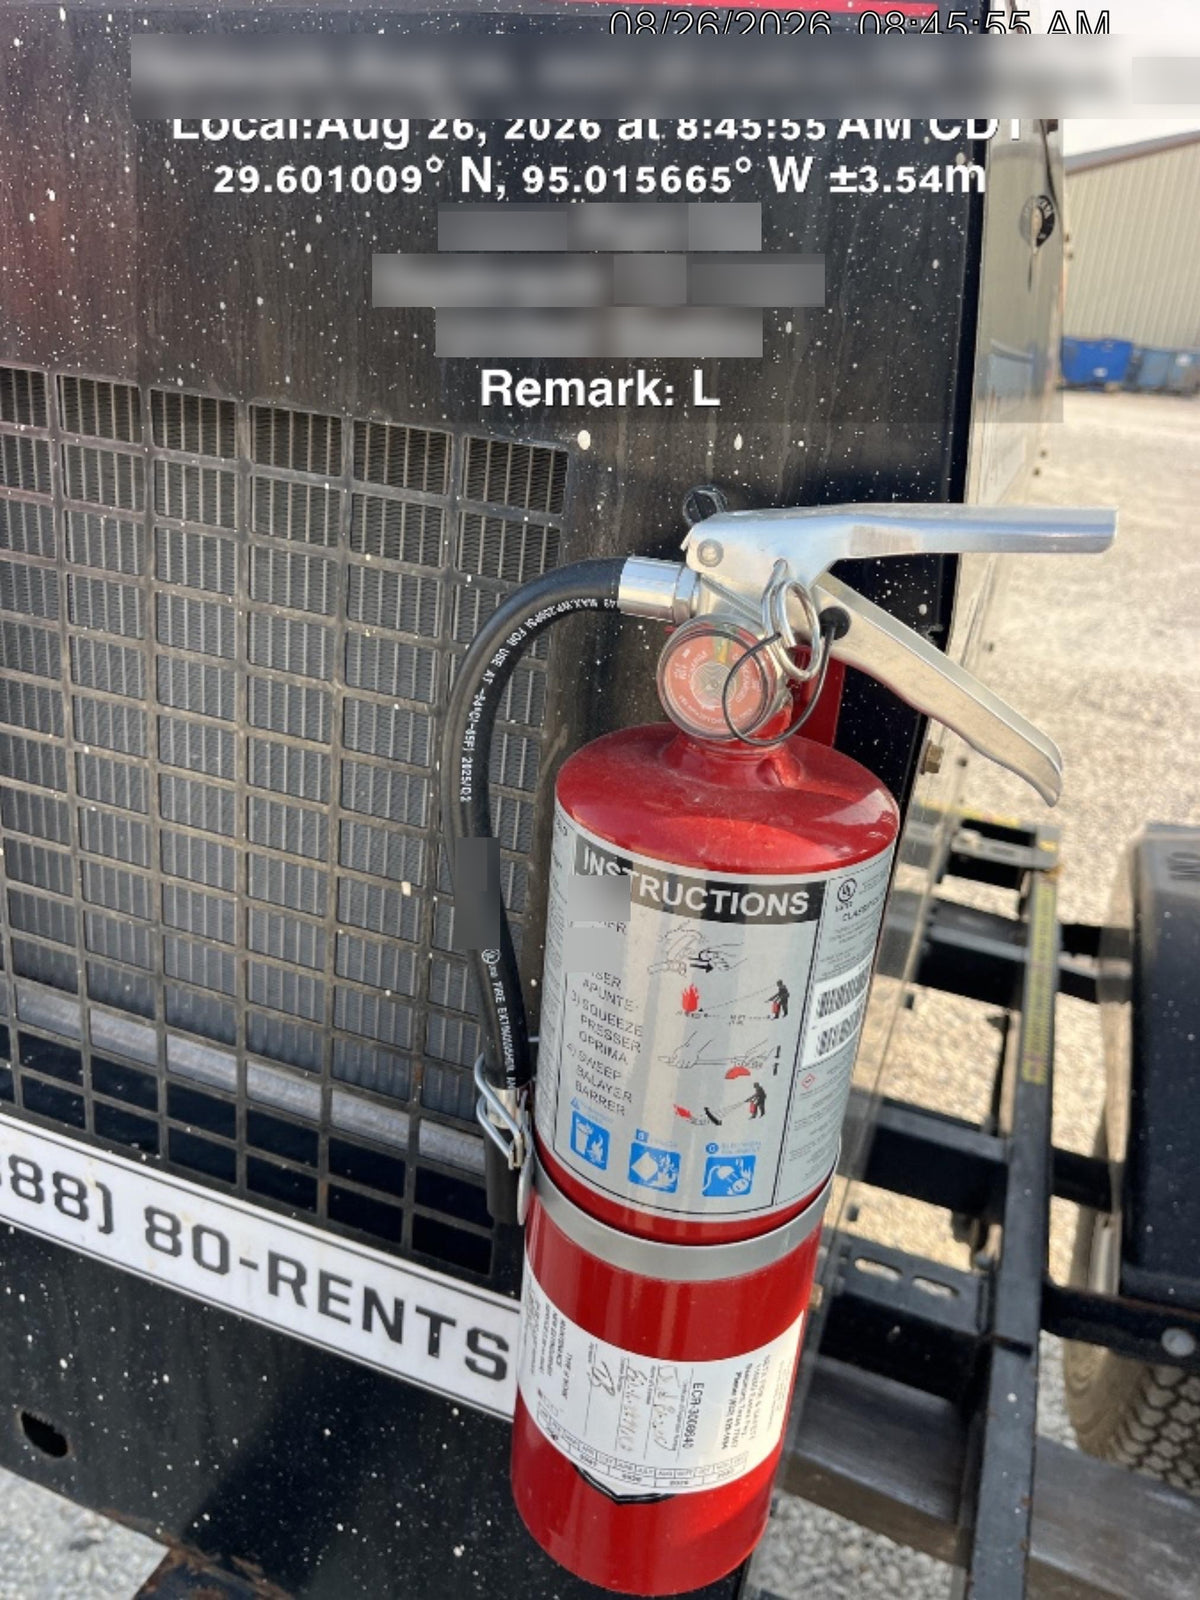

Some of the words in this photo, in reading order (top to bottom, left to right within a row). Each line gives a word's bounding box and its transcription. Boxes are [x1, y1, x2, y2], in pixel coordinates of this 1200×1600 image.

[582, 998, 643, 1038] SQUEEZE
[0, 1153, 114, 1235] 88)
[144, 1205, 511, 1382] 80-RENTS
